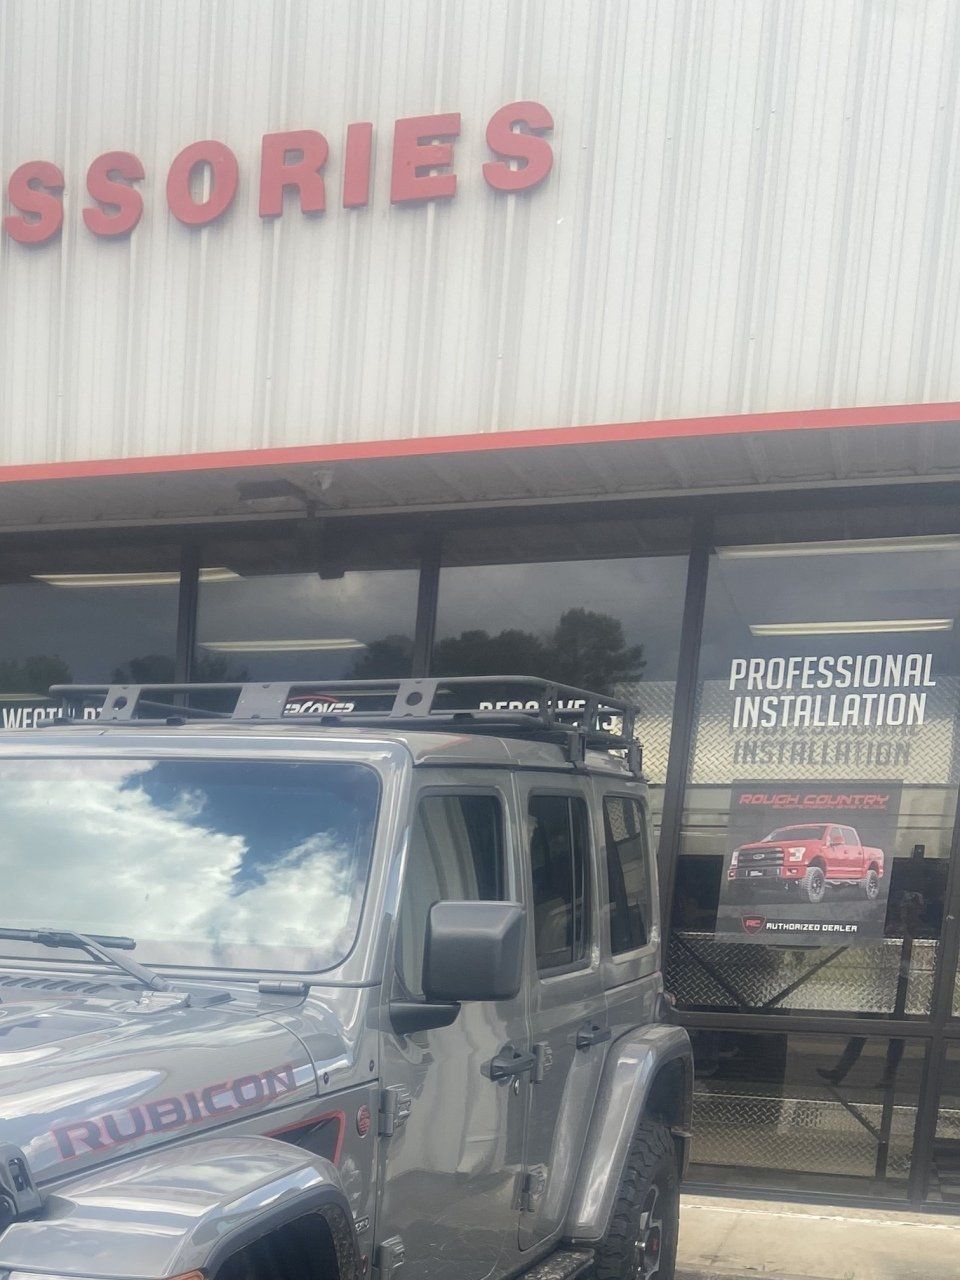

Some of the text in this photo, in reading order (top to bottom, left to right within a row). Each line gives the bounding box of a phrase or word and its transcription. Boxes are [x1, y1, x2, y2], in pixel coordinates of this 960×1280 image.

[729, 653, 937, 691] PROFESSIONAL
[732, 693, 928, 728] INSTALLATION
[739, 794, 889, 805] ROUGH COUNTRY
[766, 922, 858, 932] AUTHORIZED DEALER
[49, 1064, 299, 1161] RUBICON
